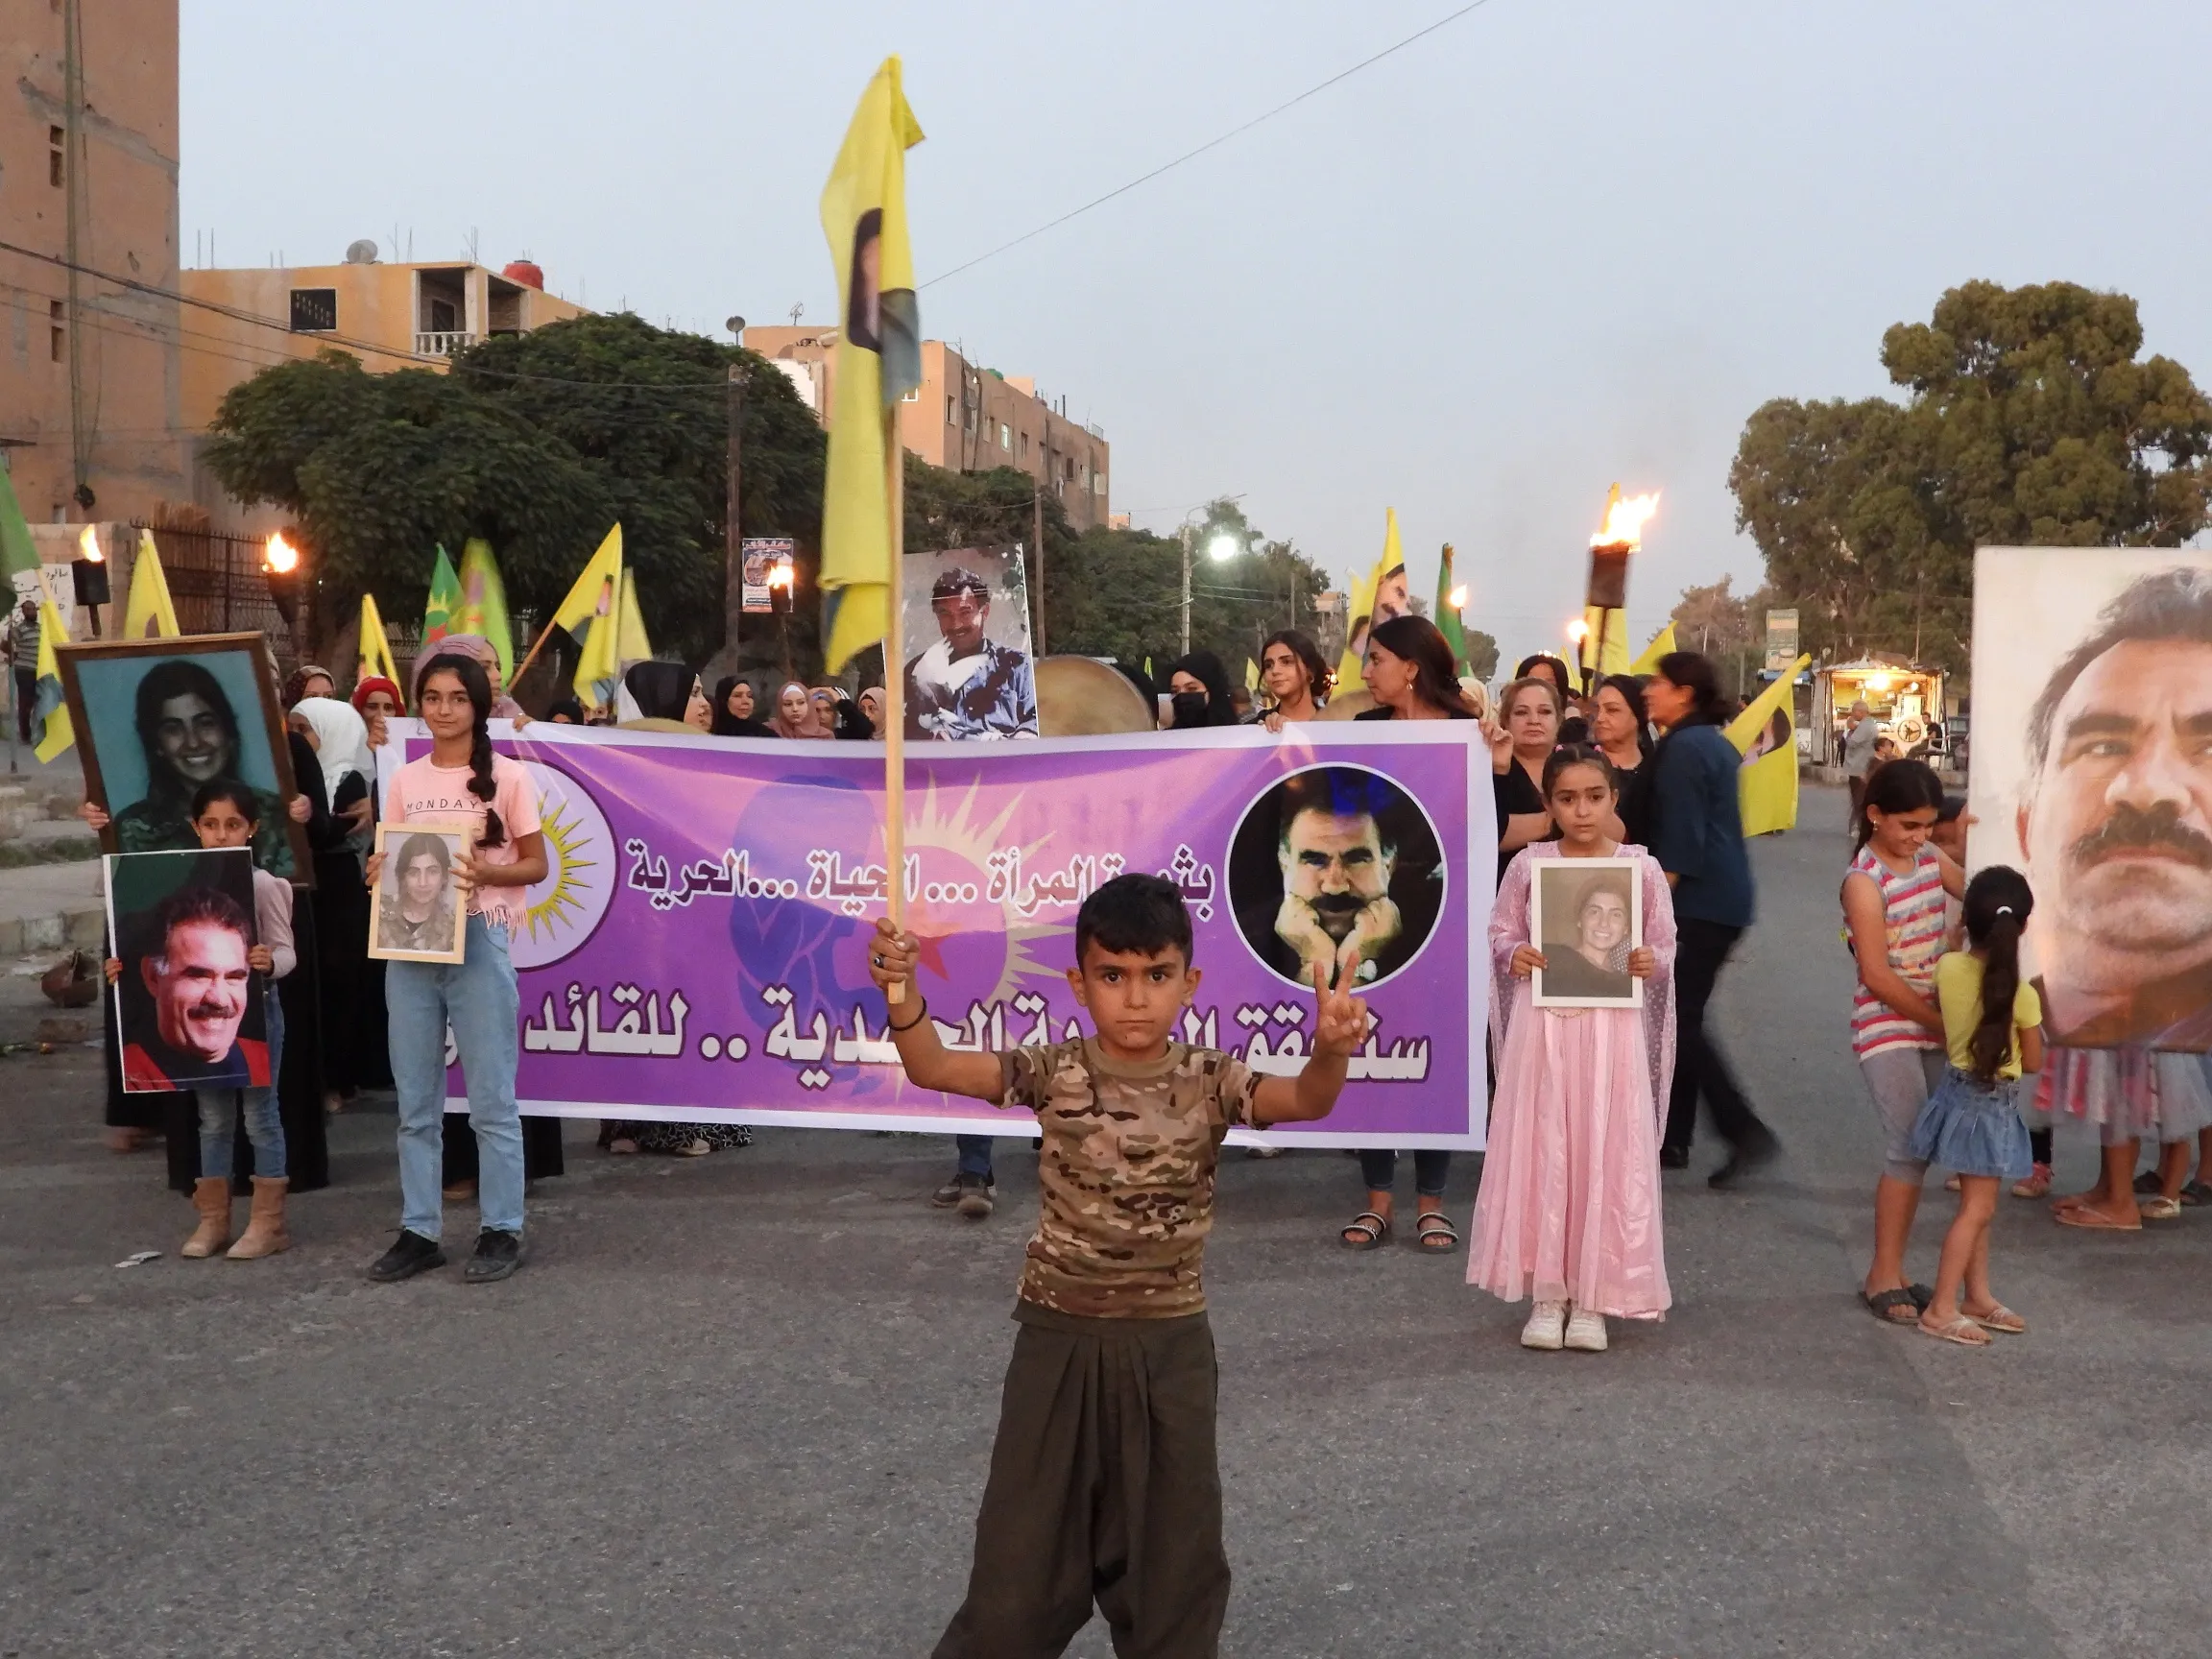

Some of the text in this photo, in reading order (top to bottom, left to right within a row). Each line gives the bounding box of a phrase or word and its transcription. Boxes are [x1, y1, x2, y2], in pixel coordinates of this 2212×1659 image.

[406, 798, 478, 812] MONDAY
[986, 846, 1095, 917] المرأة
[522, 980, 690, 1060] للقائد
[1231, 999, 1432, 1083] سنقق
